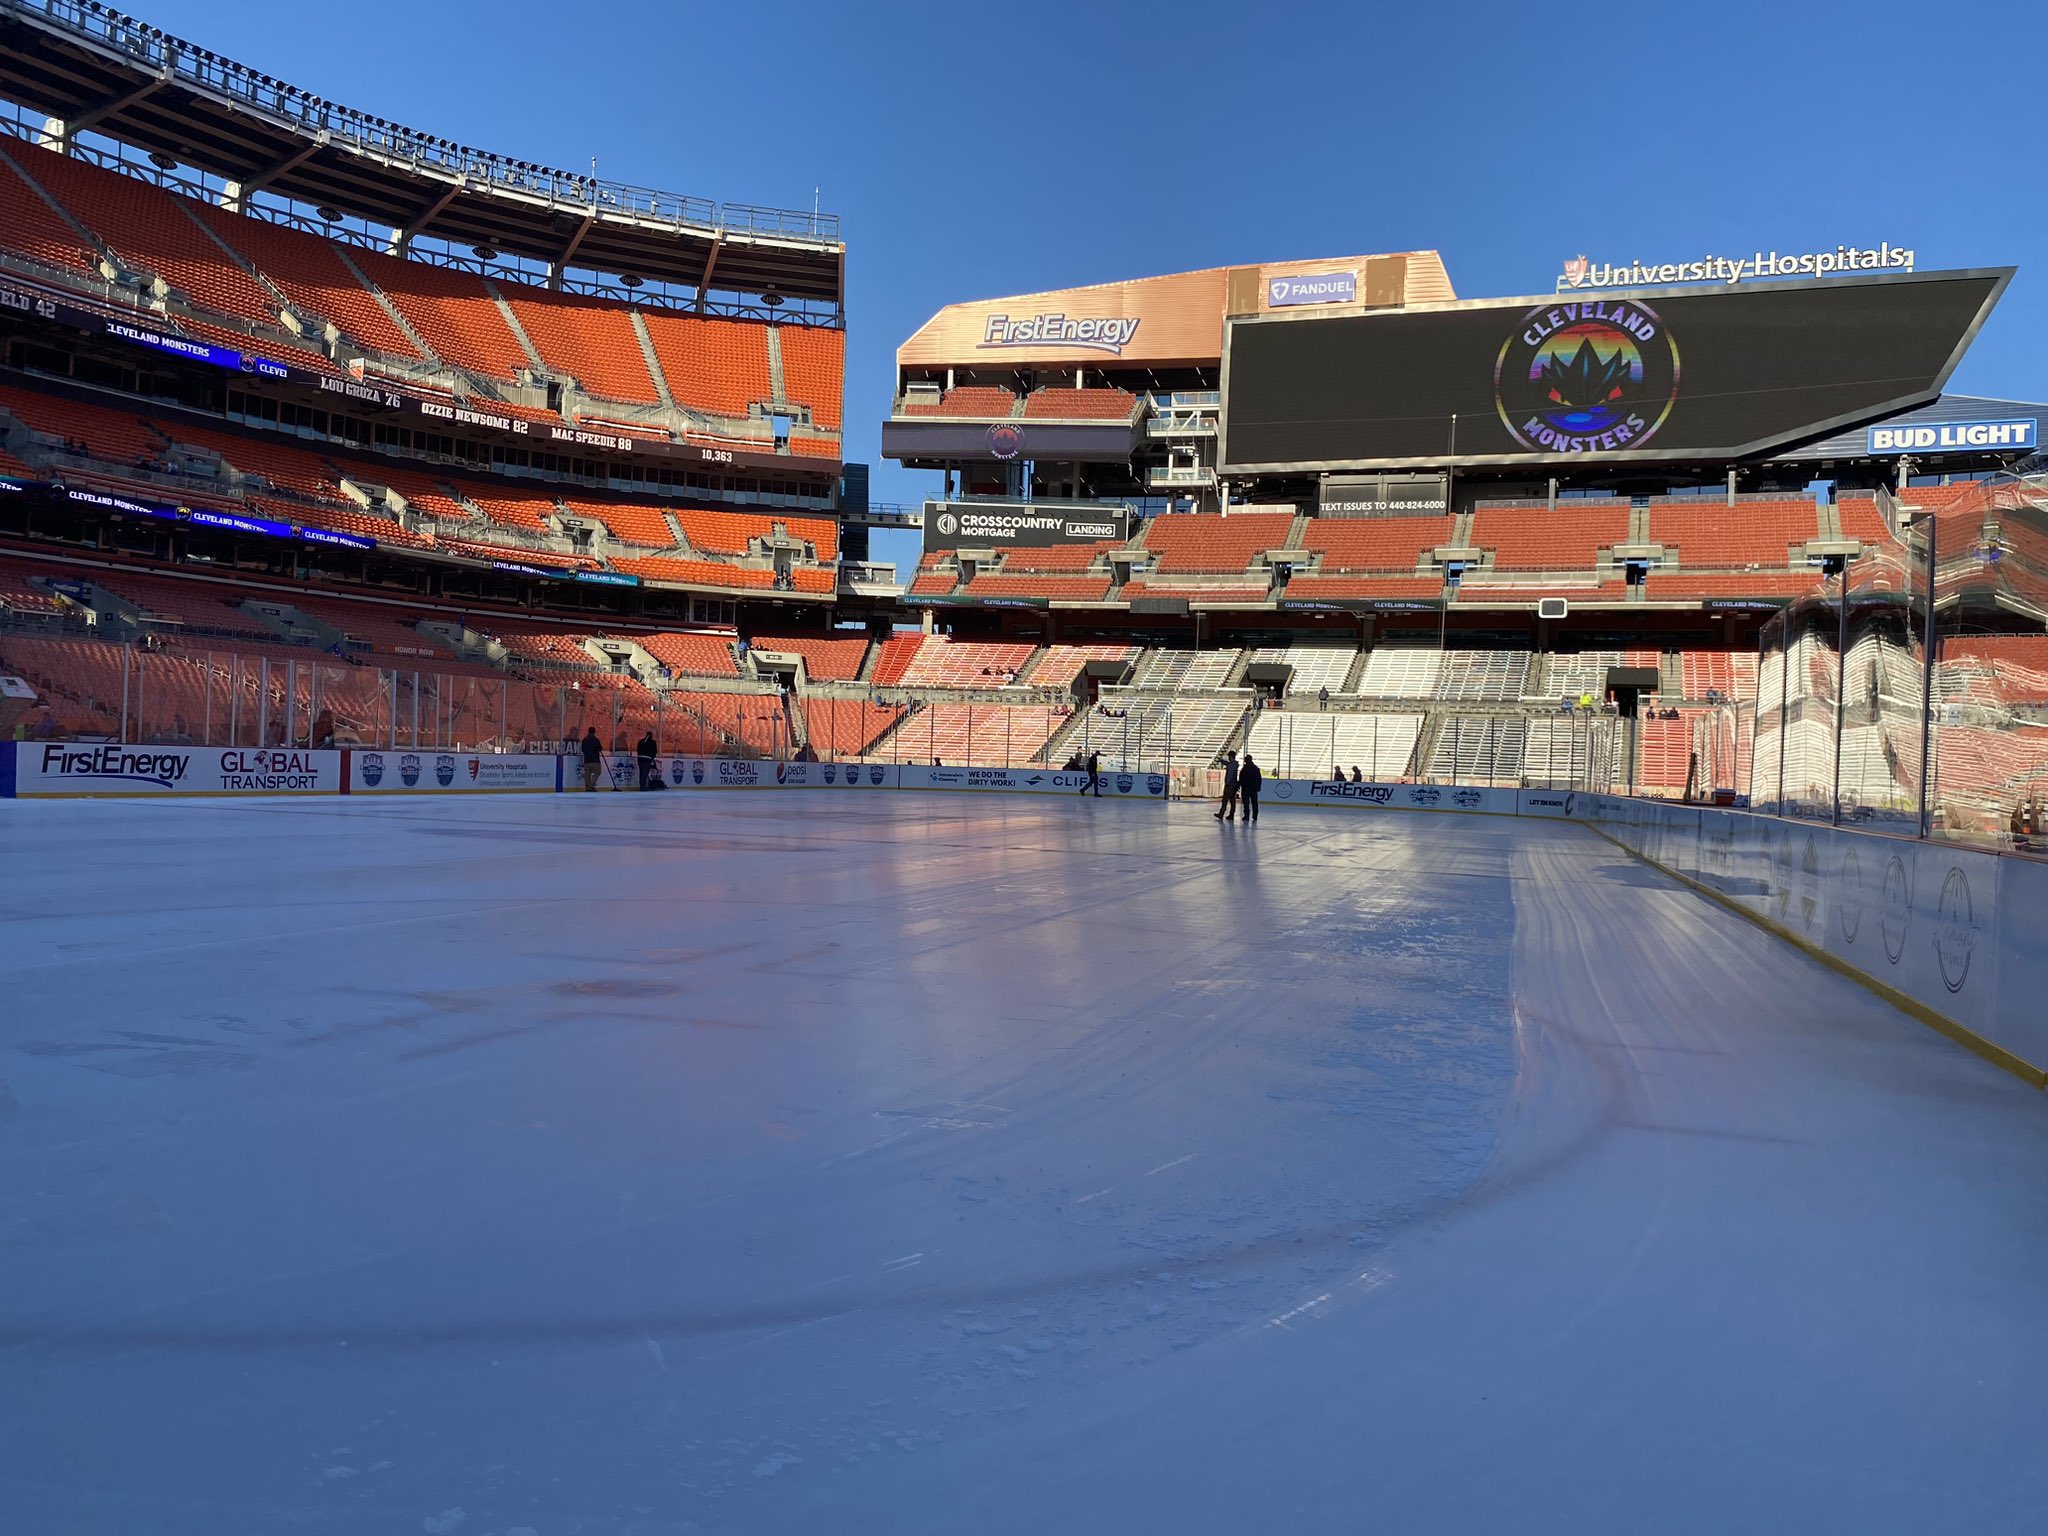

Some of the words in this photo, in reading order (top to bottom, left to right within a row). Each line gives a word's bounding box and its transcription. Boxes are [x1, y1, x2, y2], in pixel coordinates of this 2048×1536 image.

[1589, 254, 1745, 287] University
[1753, 241, 1906, 278] Hospitals
[1292, 281, 1353, 296] FANDUEL
[35, 300, 56, 319] 42
[984, 313, 1140, 346] FirstEnergy
[1523, 302, 1655, 346] CLEVELAND
[162, 337, 209, 357] MONSTERS
[320, 377, 344, 394] LOU
[345, 383, 380, 403] GROZA
[385, 392, 400, 408] 76
[421, 402, 453, 419] OZZIE
[455, 409, 510, 431] NEWSOME
[513, 419, 529, 434] 82
[551, 427, 574, 441] MAC
[575, 432, 616, 448] SPEEDIE
[618, 437, 632, 451] 88
[1523, 413, 1645, 453] MONSTERS
[1874, 428, 1937, 449] BUD
[1940, 424, 2031, 446] LIGHT
[702, 449, 732, 463] 10,363
[69, 491, 112, 506] CLEVELAND
[1320, 503, 1342, 511] TEXT
[1343, 502, 1372, 511] ISSUES
[1374, 502, 1387, 510] TO
[1389, 501, 1446, 510] 440-824-6000
[194, 512, 232, 526] CLEVELAND
[961, 515, 1063, 529] CROSSCOUNTRY
[305, 531, 338, 543] CLEVELAND
[961, 527, 1015, 538] MORTGAGE
[1068, 525, 1113, 535] LANDING
[579, 573, 609, 582] CLEVELAND
[42, 744, 190, 781] FirstEnergy
[480, 763, 504, 772] University
[505, 763, 528, 772] Hospitals
[788, 764, 806, 777] pepsi
[220, 775, 318, 789] TRANSPORT
[720, 777, 758, 785] TRANSPORT
[1053, 776, 1108, 788] CLIFS
[1310, 781, 1394, 801] FirstEnergy
